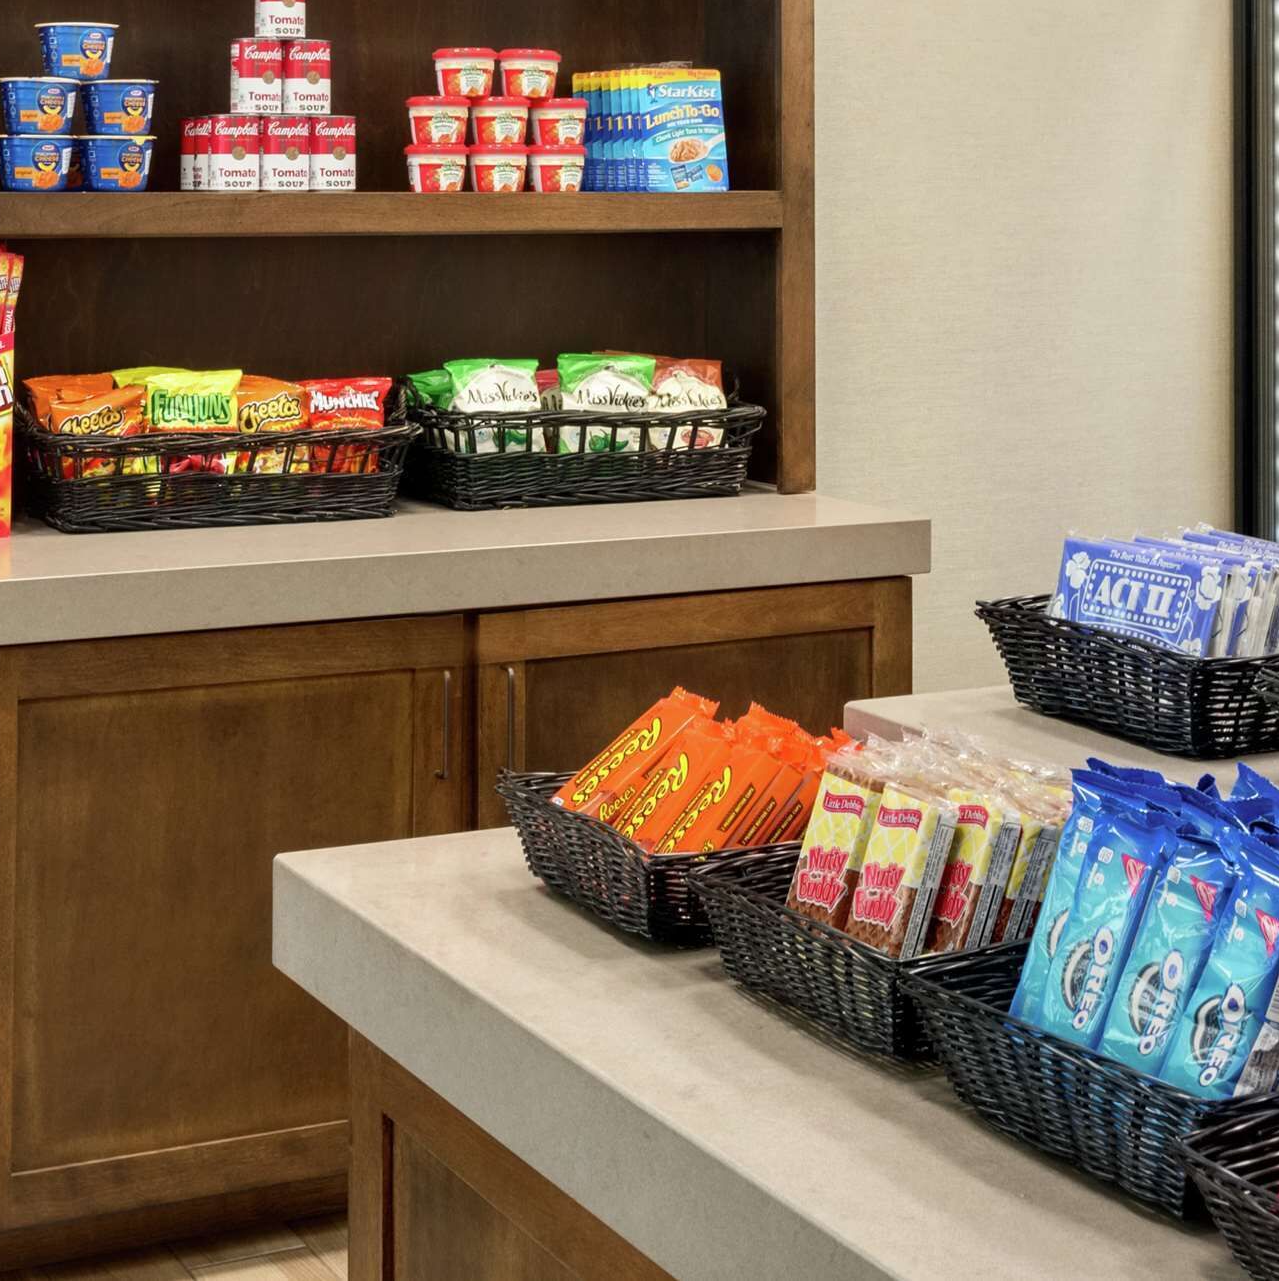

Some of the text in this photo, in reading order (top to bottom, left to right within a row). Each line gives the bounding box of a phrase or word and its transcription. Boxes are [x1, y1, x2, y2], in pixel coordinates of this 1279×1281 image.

[268, 15, 305, 25] Tomato
[275, 27, 302, 35] SOUP
[293, 92, 329, 102] Tomato
[656, 84, 716, 99] StarKist
[645, 104, 720, 130] Lunch To-Go
[219, 168, 257, 178] Tomato
[272, 168, 307, 178] Tomato
[320, 168, 355, 178] Tomato
[238, 393, 301, 432] Cheetos
[310, 389, 379, 413] MUNCHIES
[61, 405, 125, 435] Cheetos
[1093, 575, 1176, 618] ACT II
[571, 718, 662, 806] Reese's
[825, 796, 863, 811] Little Debbie
[879, 811, 920, 826] Little Debbie
[808, 846, 849, 874] Nutty
[864, 863, 906, 890] Nutty
[799, 872, 846, 911] Buddy
[855, 889, 900, 930] Buddy
[1072, 926, 1114, 1030] OREO
[1138, 949, 1184, 1055] OREO
[1199, 982, 1246, 1087] OREO
